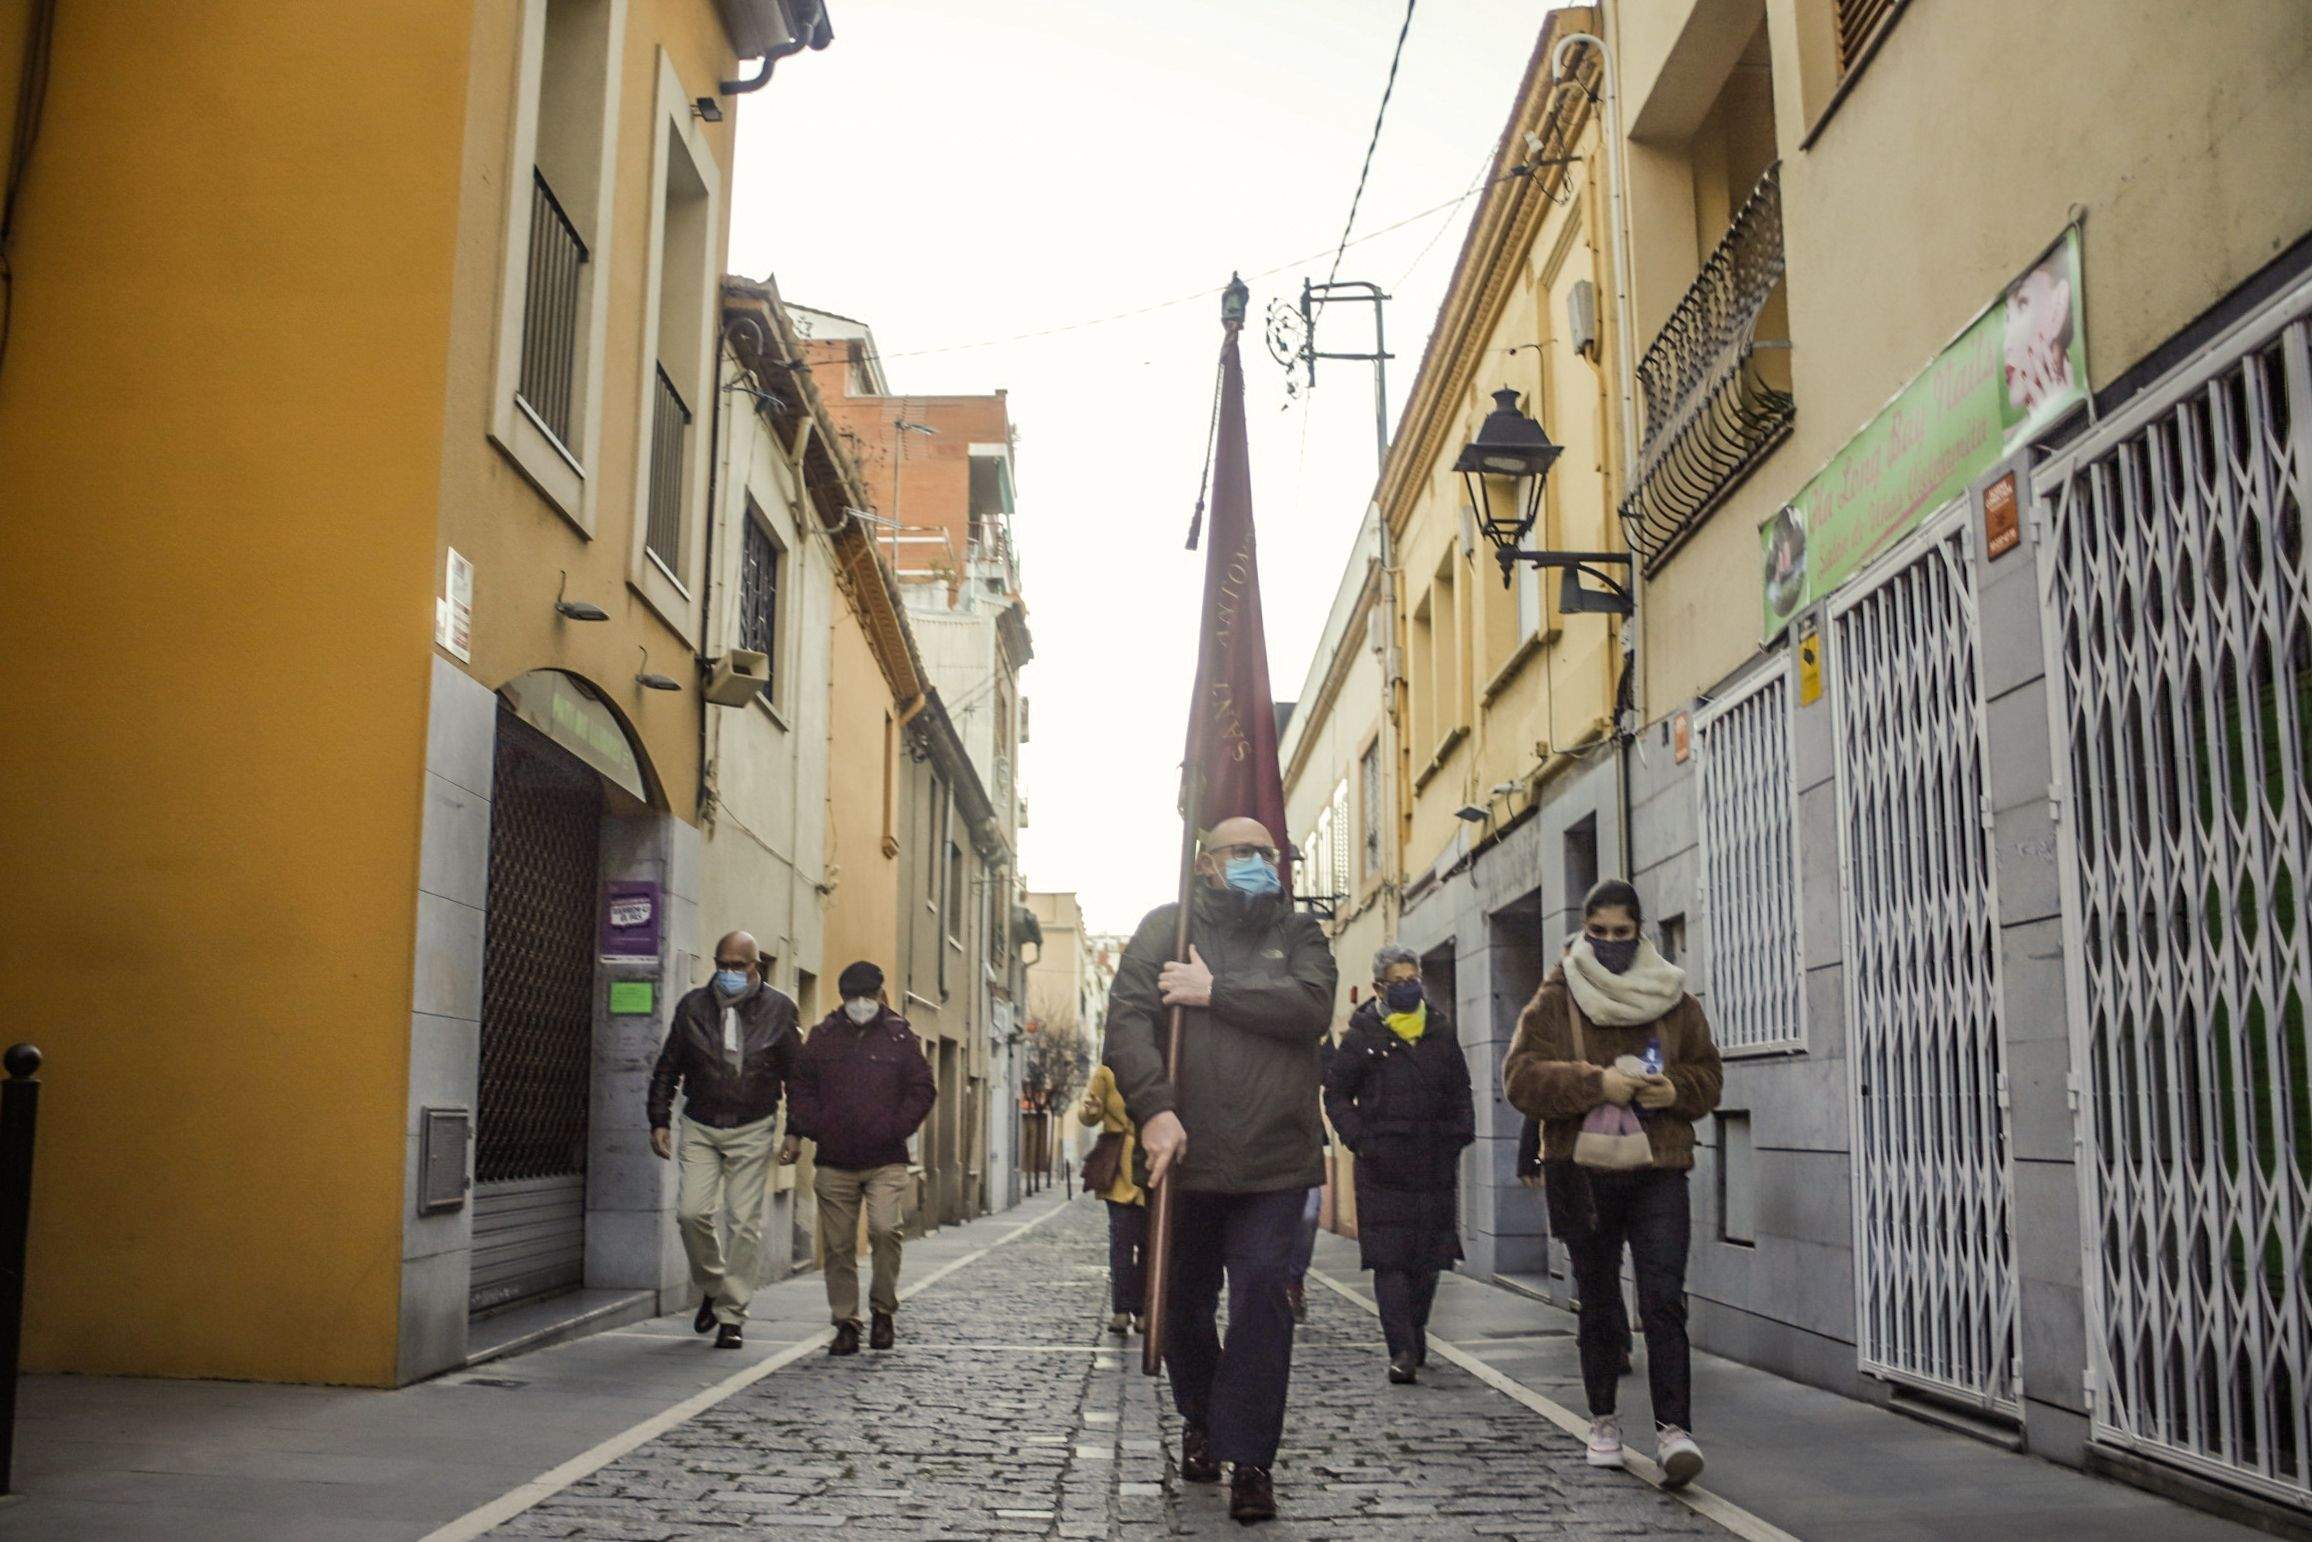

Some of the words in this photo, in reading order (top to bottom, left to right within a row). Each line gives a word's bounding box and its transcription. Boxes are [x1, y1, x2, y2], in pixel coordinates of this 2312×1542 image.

[1838, 447, 1882, 510] Long
[1887, 408, 1926, 468] Bay
[1930, 331, 1995, 421] Nails
